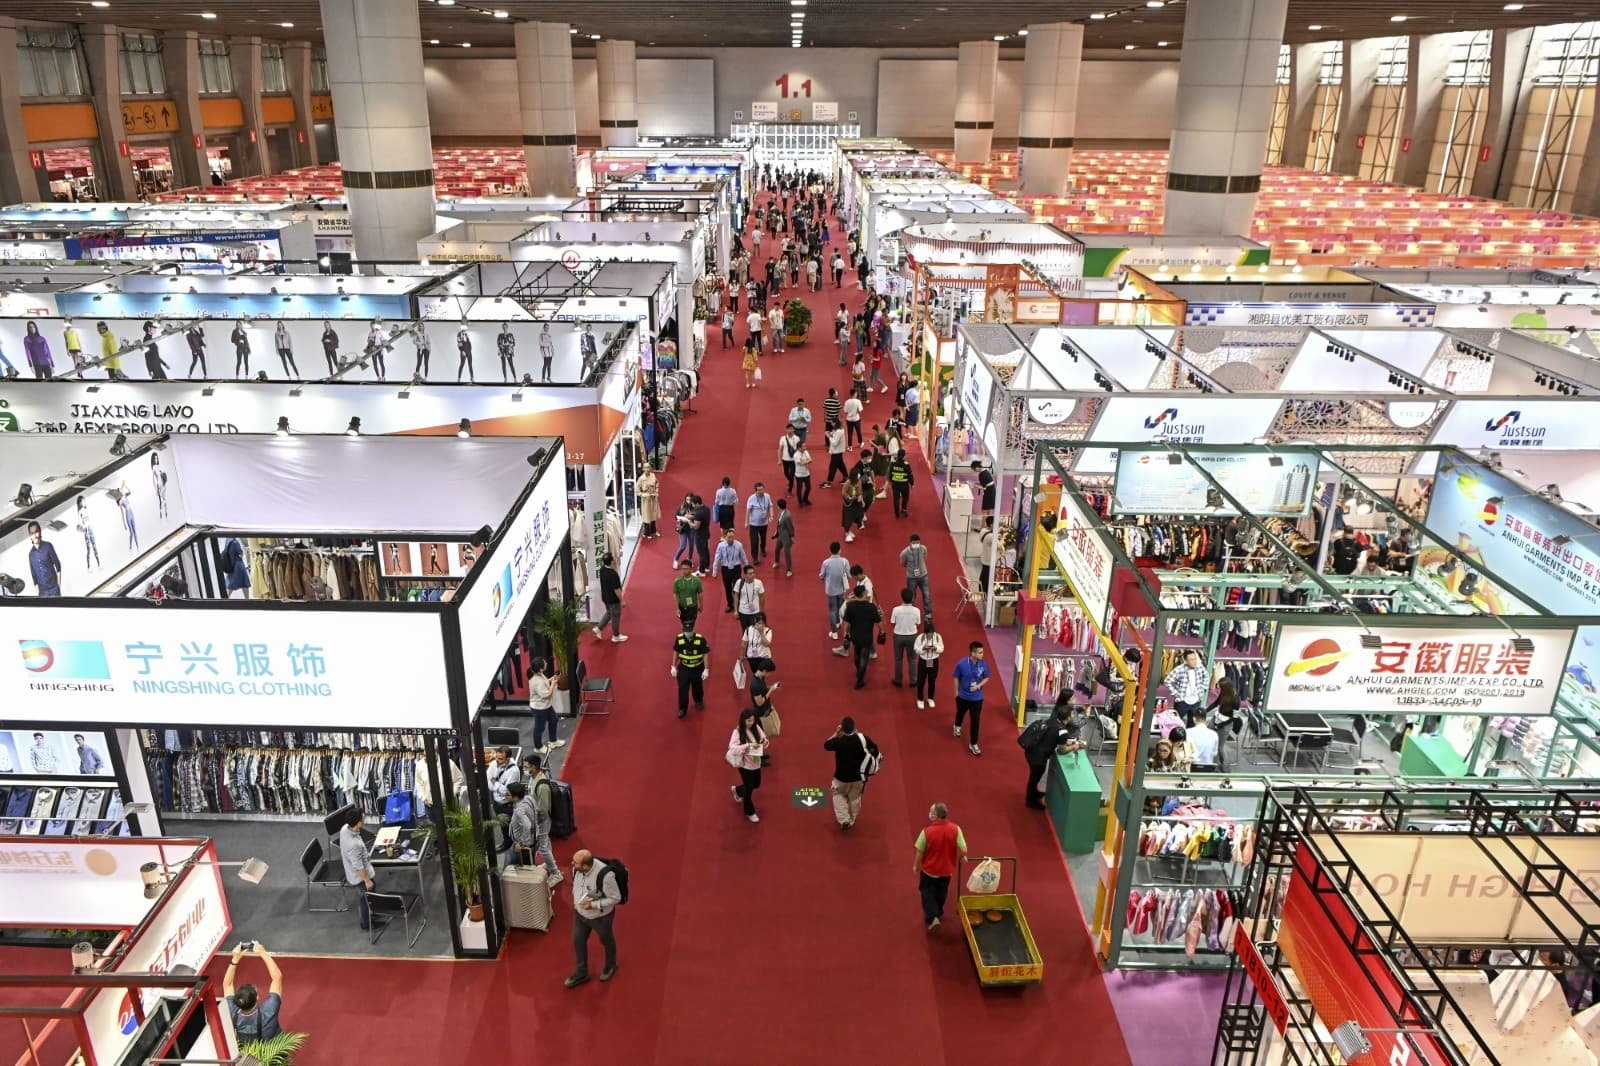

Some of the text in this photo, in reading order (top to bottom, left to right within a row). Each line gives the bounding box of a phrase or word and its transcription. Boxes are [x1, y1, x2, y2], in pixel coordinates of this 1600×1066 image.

[775, 73, 812, 98] 1.1
[33, 155, 41, 168] H
[1247, 313, 1369, 326] 湘阴县优美工贸有限公司
[71, 404, 194, 418] JIAXING LAYO
[1161, 422, 1205, 434] Justsun
[1502, 424, 1546, 437] Justsun
[514, 499, 550, 579] 宁兴服饰
[1502, 529, 1525, 550] ANHUI
[1524, 543, 1567, 576] GARMENTS
[124, 640, 328, 678] 宁兴服饰
[1370, 641, 1534, 676] 安徽服装
[29, 682, 115, 693] NINGSHING
[1346, 674, 1383, 686] ANHUI
[1385, 676, 1445, 687] GARMENTS
[132, 679, 333, 698] NINGSHING CLOTHING
